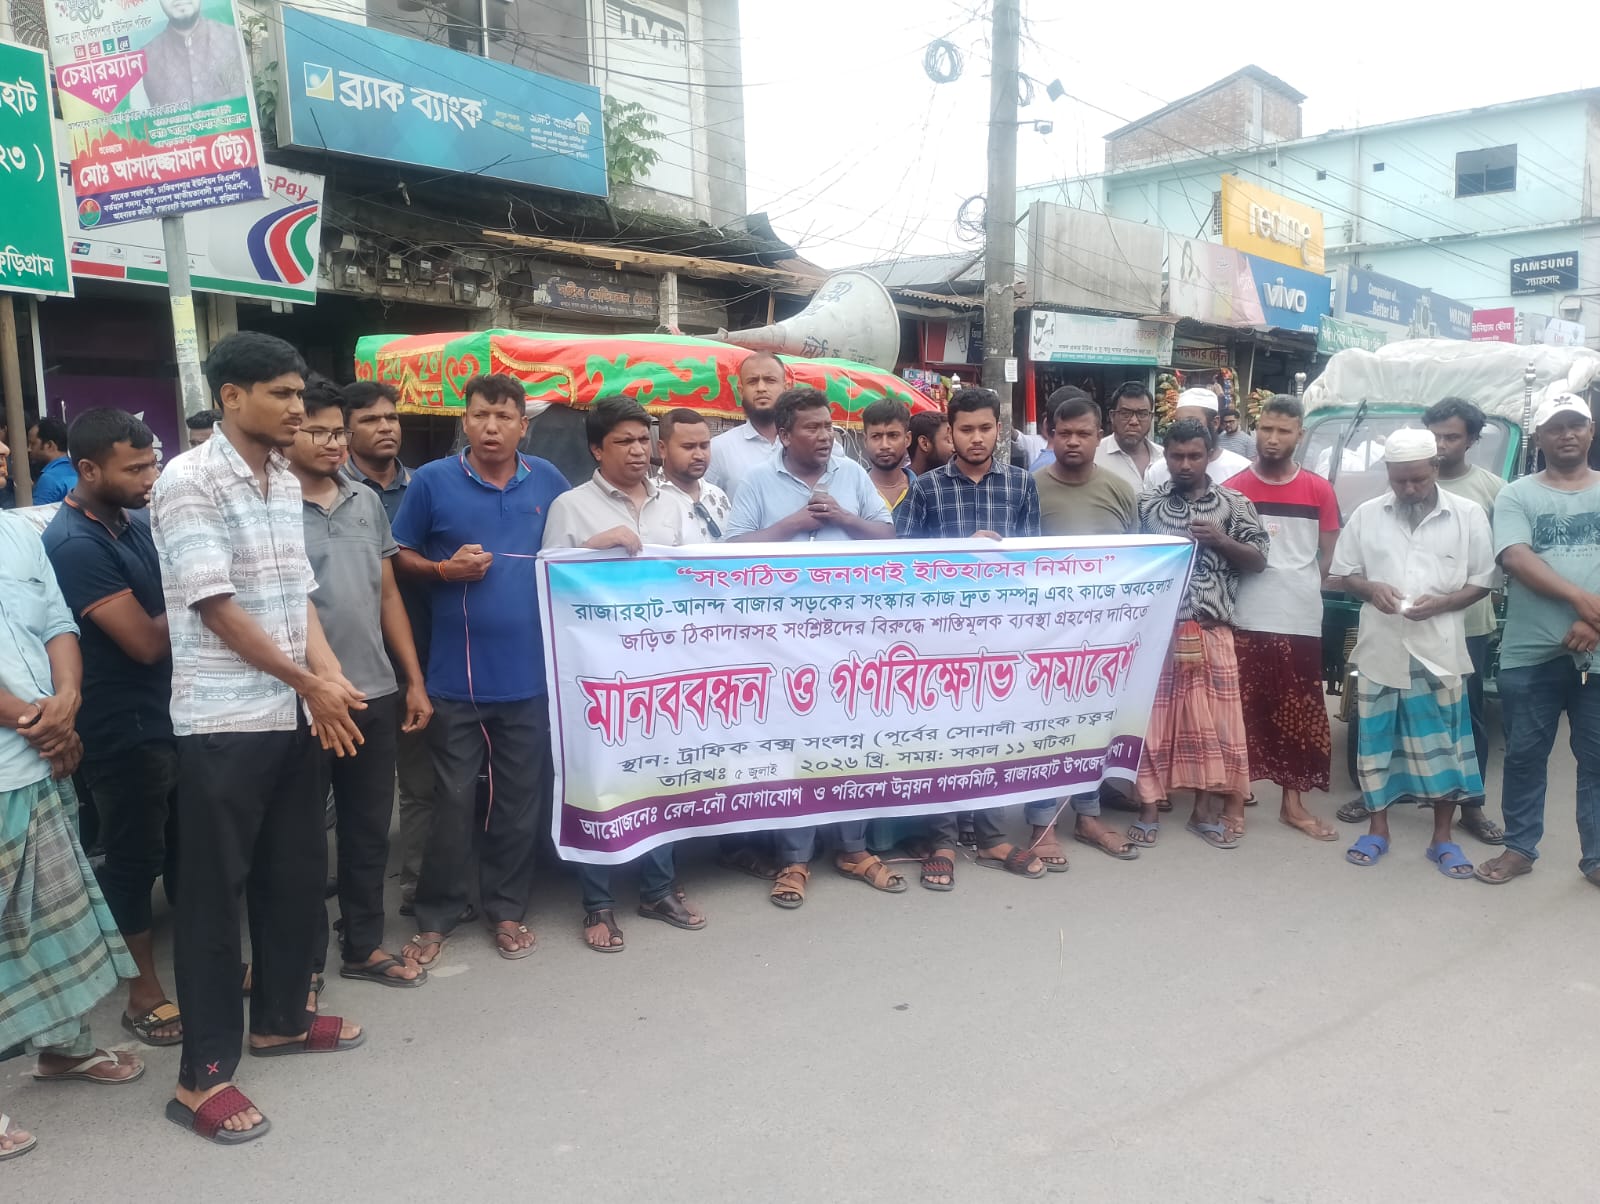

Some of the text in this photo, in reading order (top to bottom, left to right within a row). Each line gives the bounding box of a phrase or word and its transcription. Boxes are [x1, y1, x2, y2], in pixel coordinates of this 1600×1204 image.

[61, 53, 144, 88] চেয়ারম্যান
[0, 76, 38, 118] হাট
[92, 84, 118, 104] পদে
[339, 70, 405, 113] ব্র্যাক
[410, 87, 483, 131] ব্যাংক
[79, 162, 110, 188] মোঃ
[111, 145, 207, 180] আসাদুজ্জামান
[211, 134, 252, 170] (টিটু)
[1513, 256, 1574, 273] SAMSUNG
[1262, 276, 1308, 313] vivo
[677, 554, 1116, 588] “সংগঠিত জনগণই ইতিহাসের নির্মাতা”
[731, 595, 785, 615] বাজার
[791, 592, 856, 613] সড়কের
[860, 591, 916, 610] সংস্কার
[920, 590, 956, 607] কাজ
[960, 589, 991, 609] দ্রুত
[996, 586, 1039, 608] সম্পন্ন
[1044, 585, 1075, 602] এবং
[1077, 584, 1117, 600] কাজে
[1120, 578, 1174, 597] অবহেলায়
[620, 603, 1150, 652] জড়িত ঠিকাদারসহ সংশ্লিষ্টদের বিরুদ্ধে শাস্তিমূলক ব্যবস্থা গ্রহণের দাবিতে
[578, 664, 775, 744] মানববন্ধন
[784, 665, 817, 714] ও
[831, 642, 1023, 718] গণবিক্ষোভ
[657, 733, 1077, 788] তারিখঃ ৫ জুলাই ২০২৬ খ্রি. সময়: সকাল ১১ ঘটিকা
[676, 740, 750, 766] ট্রাফিক
[756, 738, 796, 752] বক্স
[801, 732, 865, 751] সংলগ্ন
[873, 724, 940, 748] (পূর্বের
[947, 719, 1016, 739] সোনালী
[1021, 716, 1072, 733] ব্যাংক
[579, 805, 658, 841] আয়োজনেঃ
[664, 791, 728, 821] রেল-নৌ
[731, 784, 804, 811] যোগাযোগ
[813, 786, 826, 801] ও
[831, 779, 888, 801] পরিবেশ
[891, 775, 934, 801] উন্নয়ন
[937, 766, 999, 792] গণকমিটি,
[1003, 758, 1061, 784] রাজারহাট
